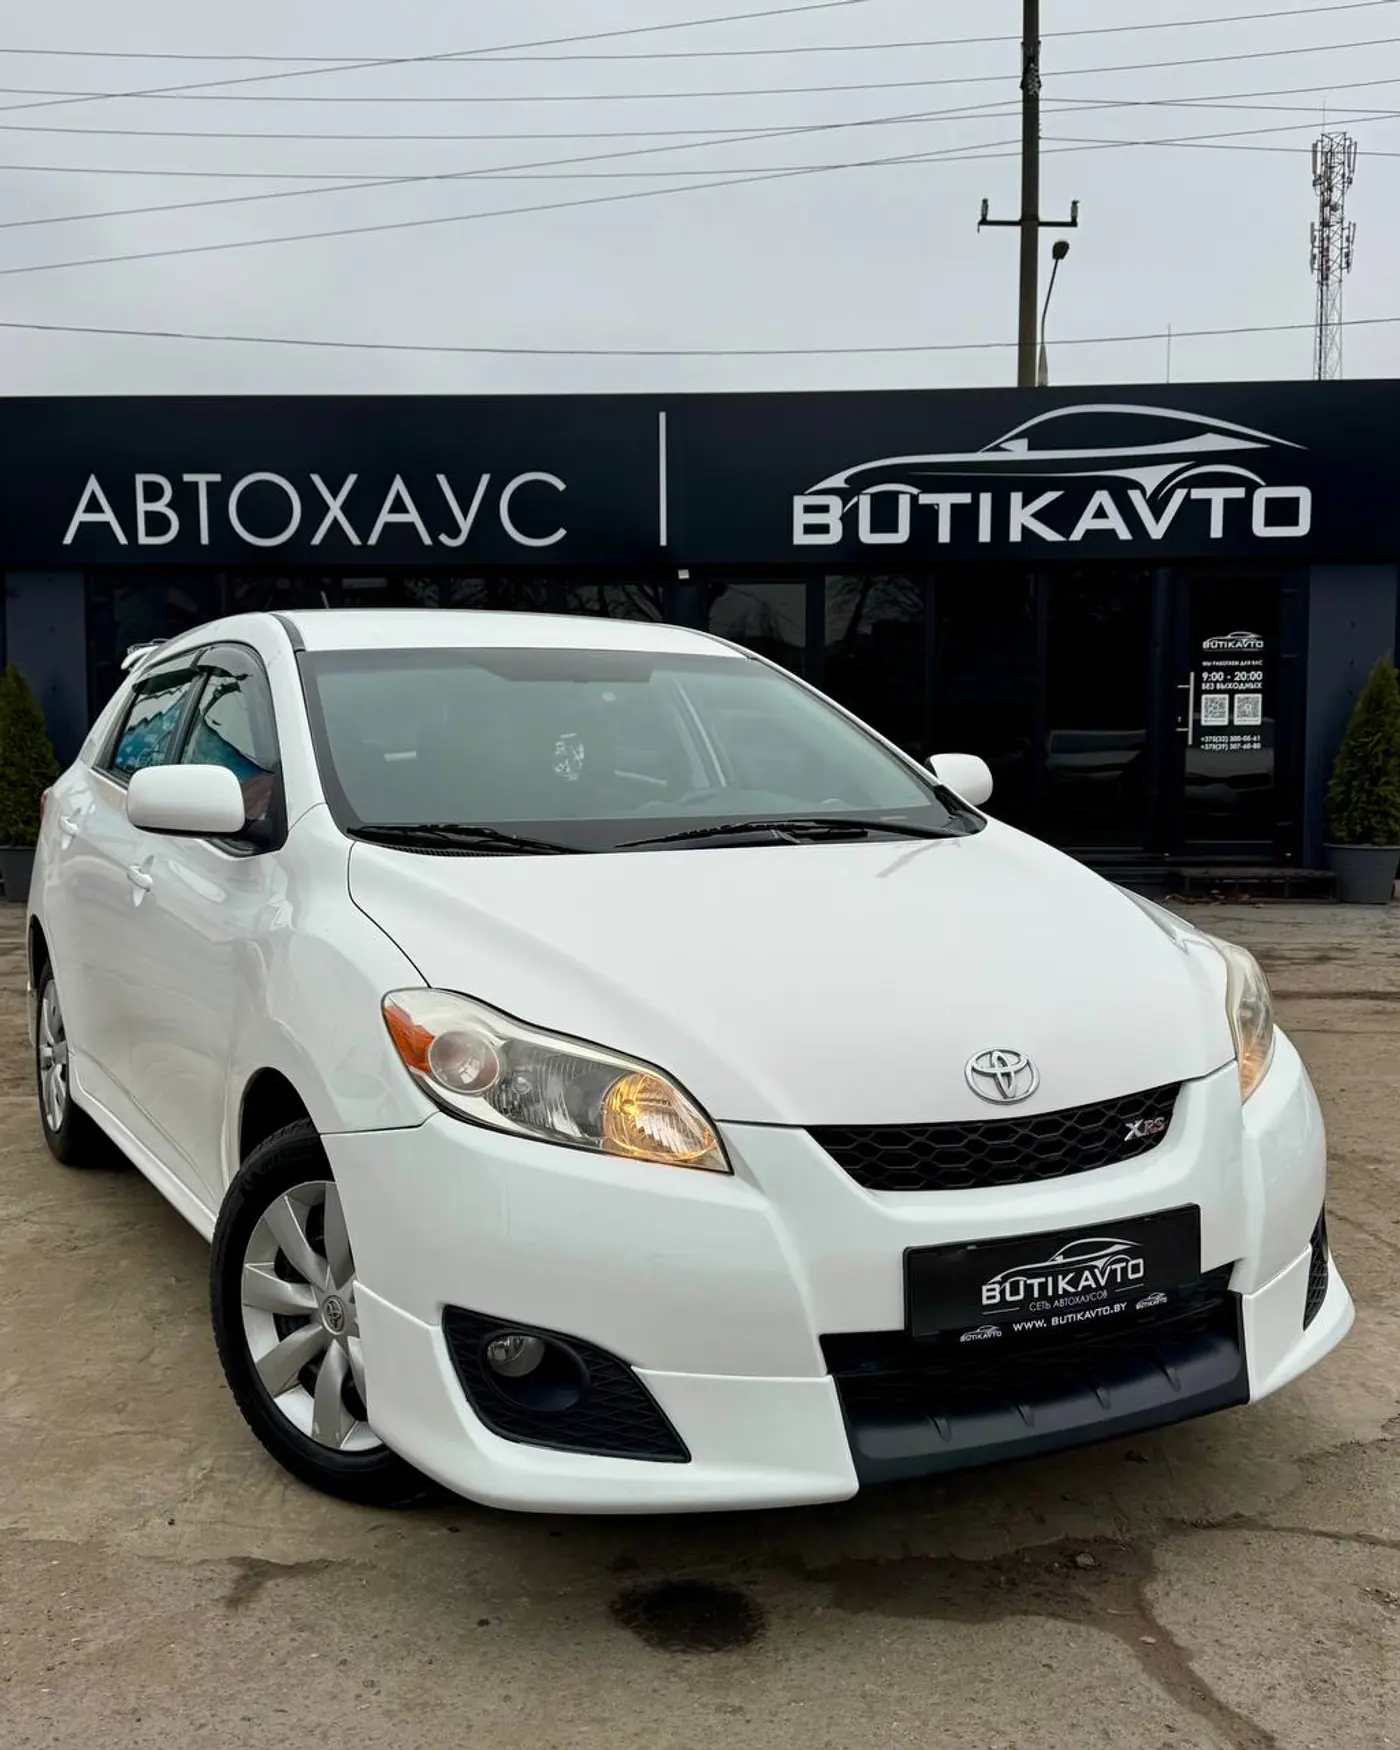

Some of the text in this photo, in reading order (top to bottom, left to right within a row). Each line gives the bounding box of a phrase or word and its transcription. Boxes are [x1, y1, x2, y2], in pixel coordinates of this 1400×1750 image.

[62, 471, 568, 547] АВТОХАУС
[792, 486, 1312, 545] BUTIKAVTO
[1202, 640, 1264, 649] BUTIKAVTO
[1202, 671, 1224, 681] 9:00
[1233, 671, 1263, 681] 20:00
[1216, 682, 1263, 690] ВЫХОДНЫХ
[1124, 1116, 1165, 1141] XRS
[981, 1258, 1145, 1306] BUTIKAVTO
[1028, 1289, 1108, 1312] СЕТЬ АВТОХАУСОВ
[1051, 1301, 1128, 1327] BUTIKAVTO.BY
